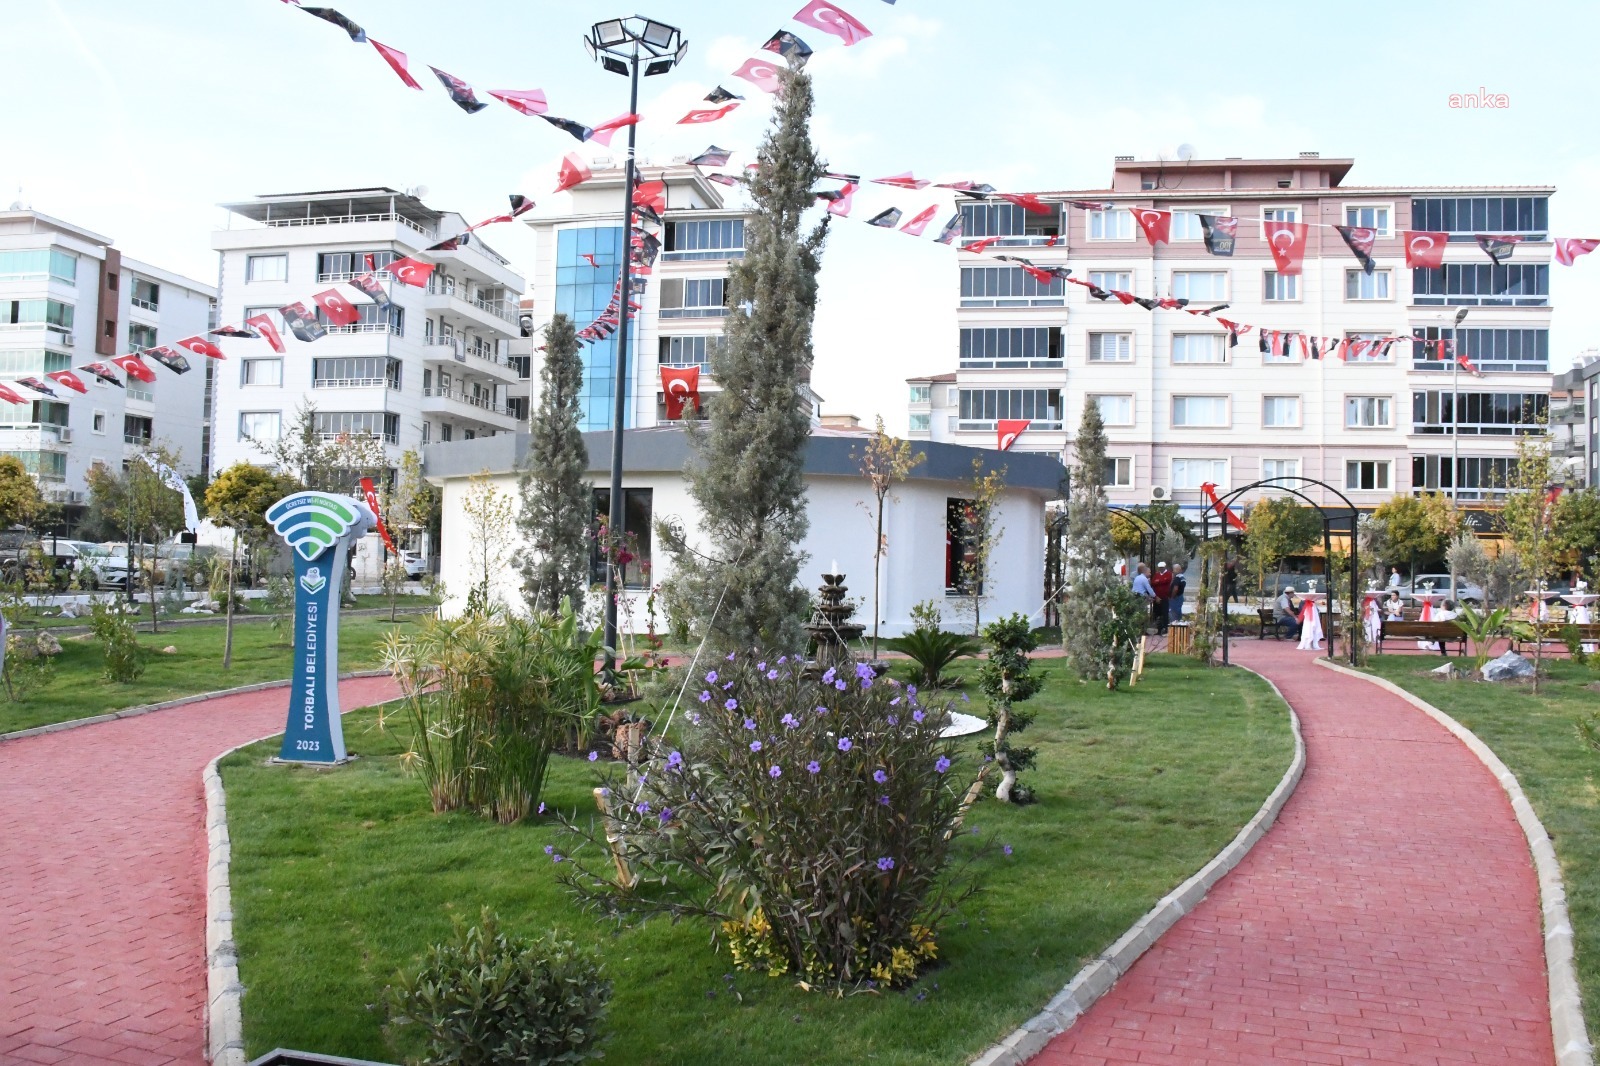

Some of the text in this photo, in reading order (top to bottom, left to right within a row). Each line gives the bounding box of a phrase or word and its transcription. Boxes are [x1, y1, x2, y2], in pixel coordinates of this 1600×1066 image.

[304, 601, 318, 730] TORBALI BELEDİYESİ
[296, 739, 320, 751] 2023
